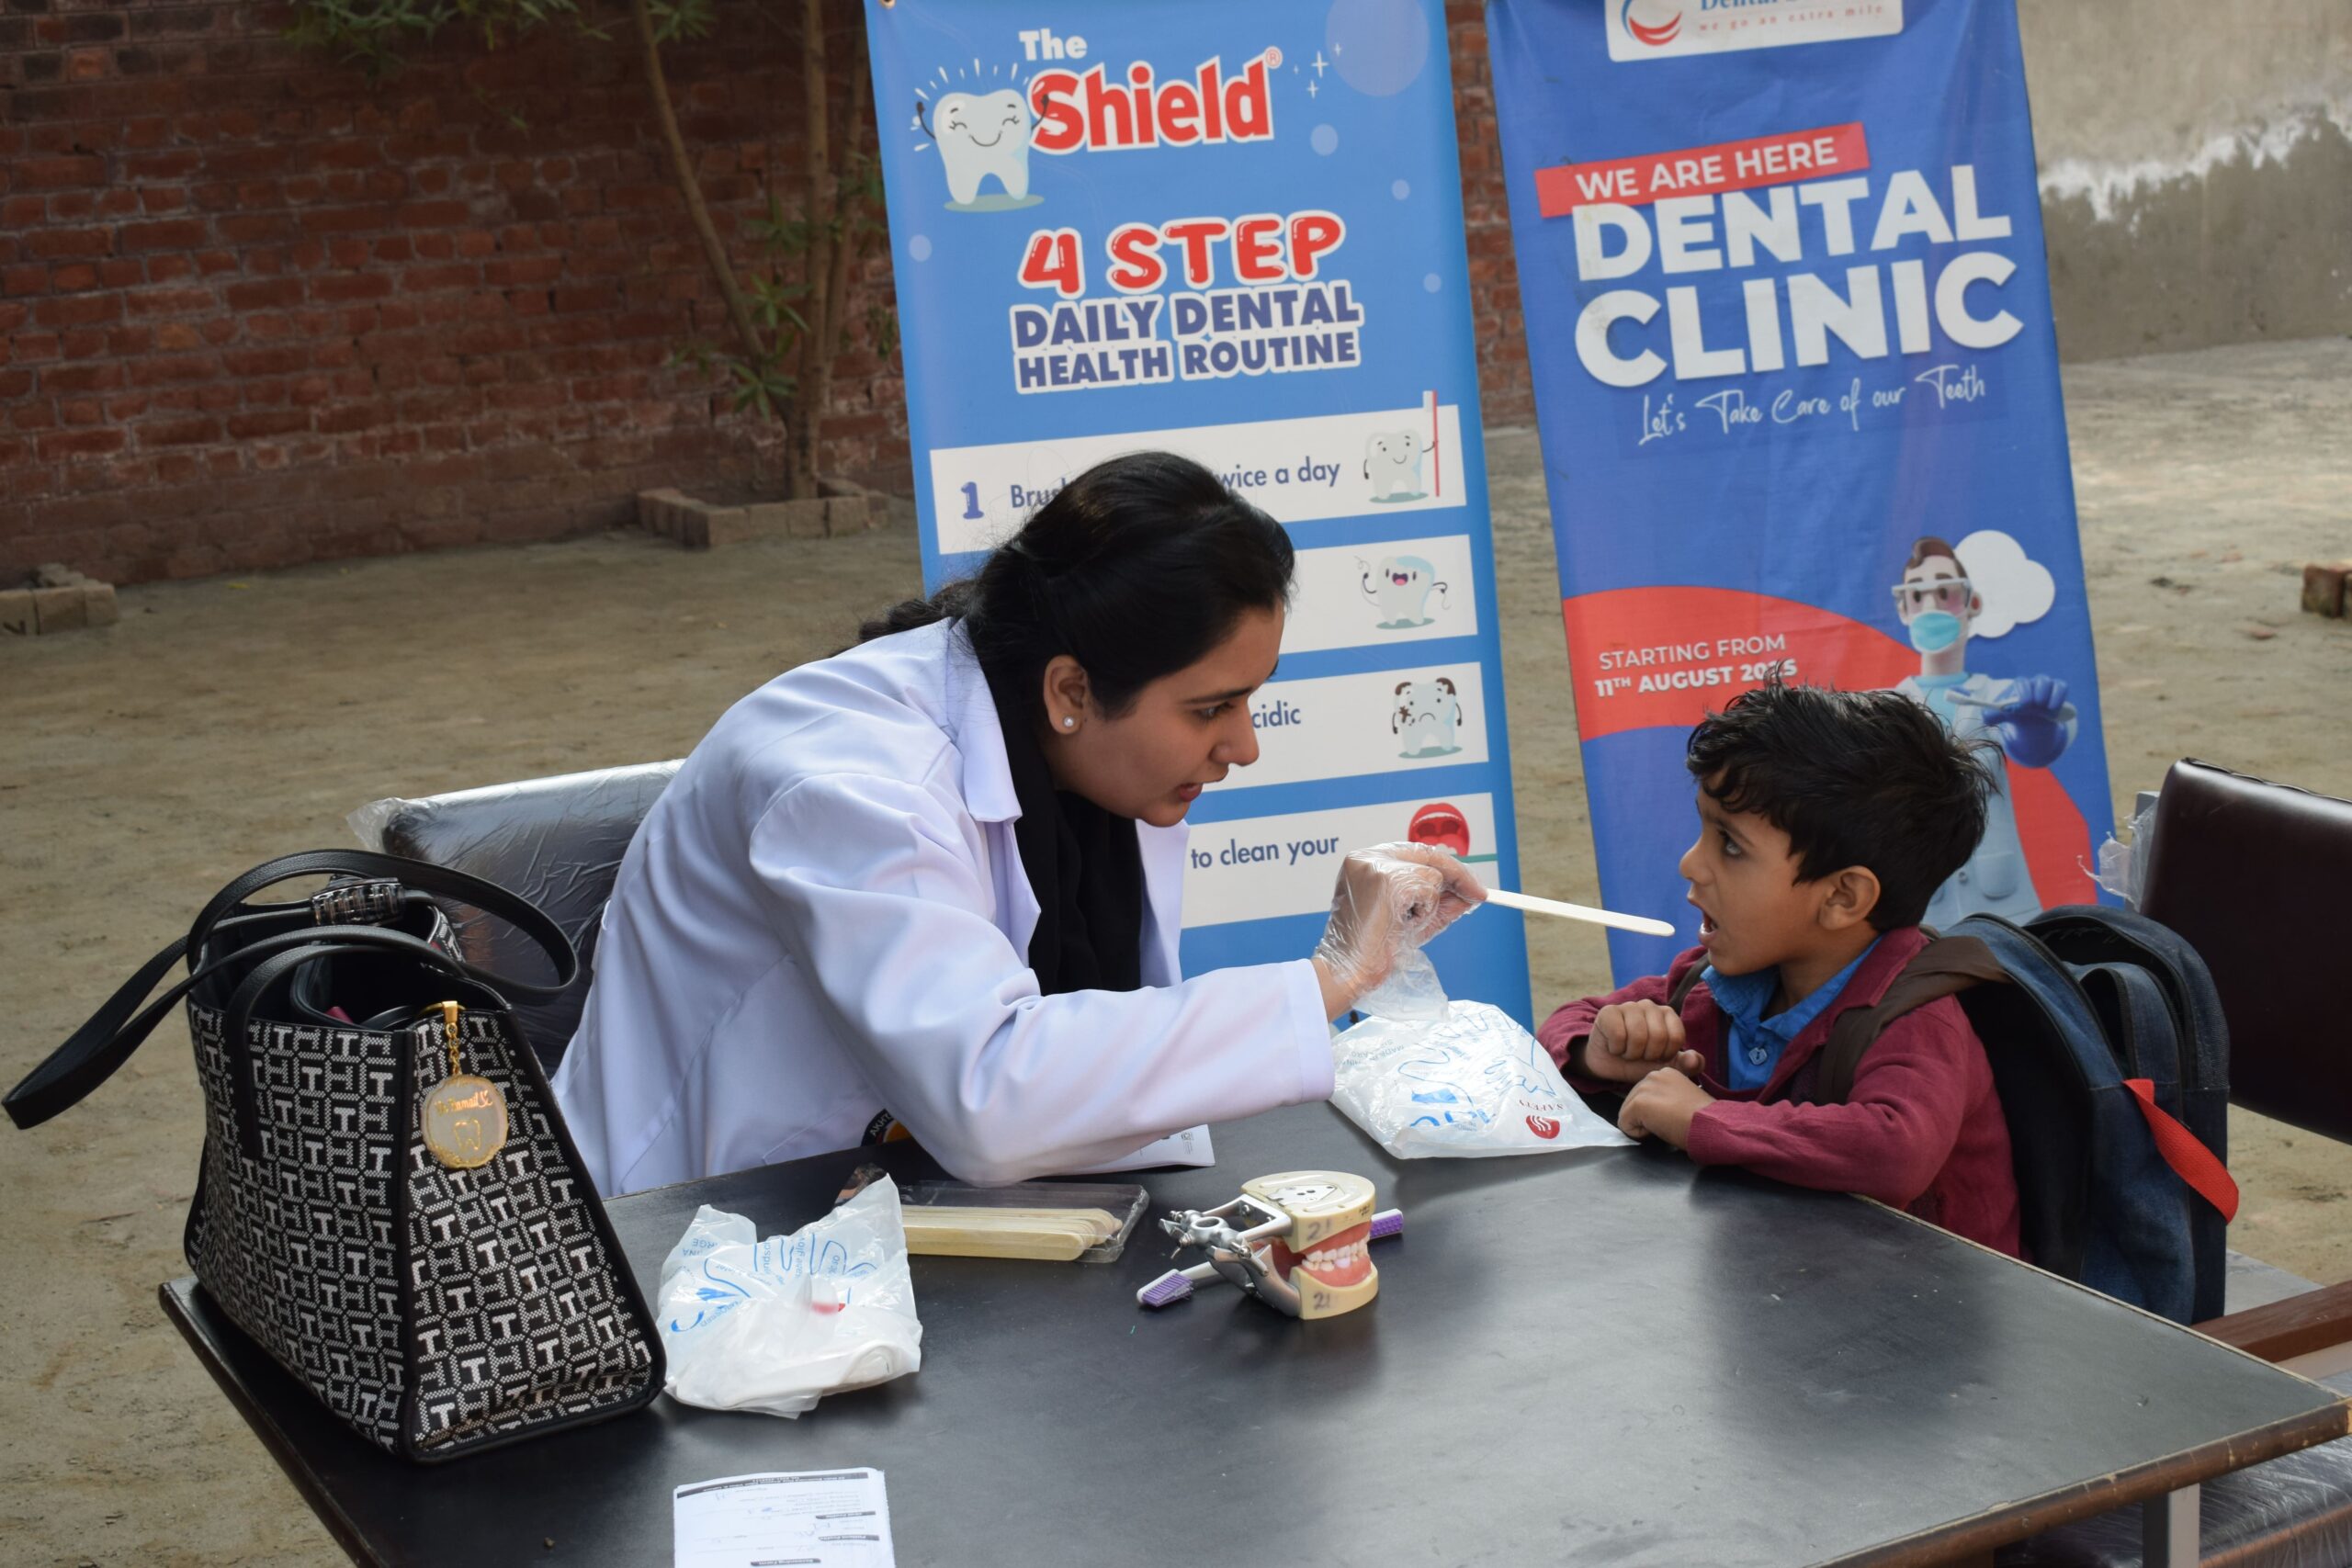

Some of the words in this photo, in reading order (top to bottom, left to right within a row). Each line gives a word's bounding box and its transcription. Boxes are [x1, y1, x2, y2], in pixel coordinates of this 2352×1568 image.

[1019, 28, 1087, 62] The
[1030, 58, 1272, 152] Shield
[1575, 170, 1639, 201] WE
[1649, 154, 1725, 193] ARE
[1735, 137, 1838, 180] HERE
[1572, 164, 2012, 281] DENTAL
[1021, 230, 1081, 296] 4
[1111, 213, 1343, 290] STEP
[1013, 301, 1159, 348] DAILY
[1176, 286, 1360, 336] DENTAL
[1575, 251, 2024, 388] CLINIC
[1017, 346, 1170, 389] HEALTH
[1183, 331, 1357, 376] ROUTINE
[1694, 389, 1763, 434] Take
[1771, 389, 1830, 424] Care
[1840, 378, 1861, 432] of
[1872, 386, 1906, 408] our
[1915, 364, 1986, 410] Teeth
[1218, 464, 1268, 489] wice
[1275, 468, 1289, 484] a
[1297, 456, 1340, 488] day
[961, 481, 985, 520] 1
[1011, 478, 1068, 508] Brus
[1599, 642, 1710, 671] STARTING
[1716, 634, 1786, 658] FROM
[1594, 676, 1632, 697] 11TH
[1638, 666, 1734, 694] AUGUST
[1251, 700, 1302, 729] cidic
[1191, 849, 1213, 869] to
[1220, 839, 1280, 865] clean
[1286, 837, 1340, 865] your
[1519, 1099, 1564, 1111] SAFETY
